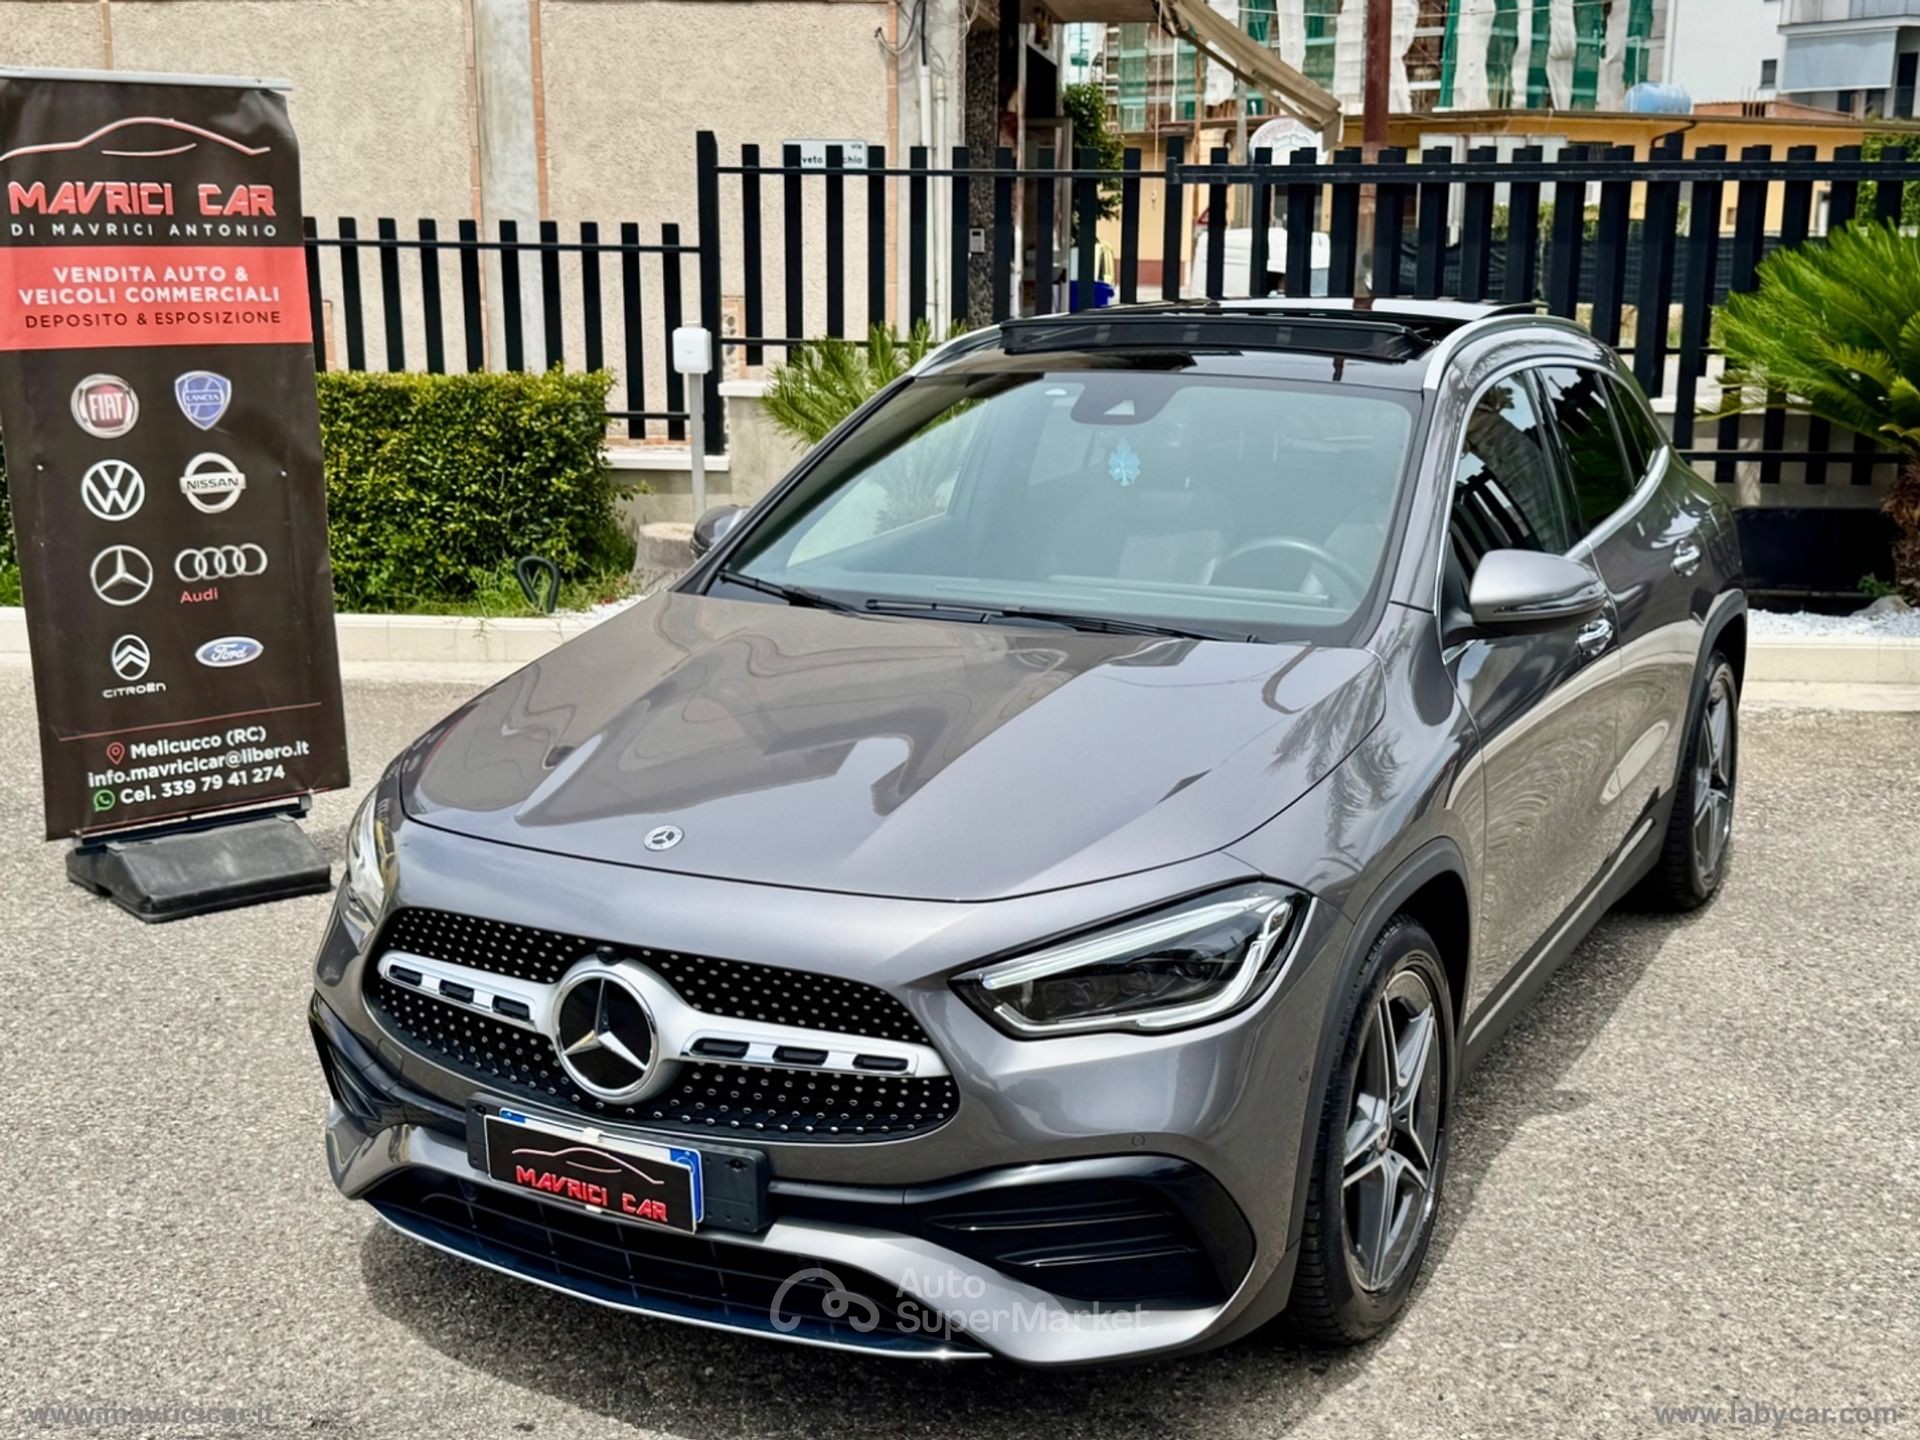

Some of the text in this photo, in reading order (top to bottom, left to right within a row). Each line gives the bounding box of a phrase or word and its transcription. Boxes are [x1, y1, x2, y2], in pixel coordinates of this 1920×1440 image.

[8, 181, 276, 216] MAVRICI CAR
[11, 223, 277, 237] DI MAVRICI ANTONIO
[53, 266, 248, 283] VENDITA AUTO &
[18, 286, 280, 305] VEICOLI COMMERCIALI
[25, 311, 281, 328] DEPOSITO & ESPOSIZIONE
[88, 393, 124, 421] FIAT
[186, 477, 239, 490] NISSAN
[179, 588, 219, 604] Audi
[210, 643, 247, 662] Ford
[130, 725, 267, 760] Melicucco (RC)
[88, 740, 310, 788] info.mavricicar@libero.it
[120, 764, 286, 805] Cel. 339 79 41 274
[515, 1164, 668, 1223] MAVRICI CAR
